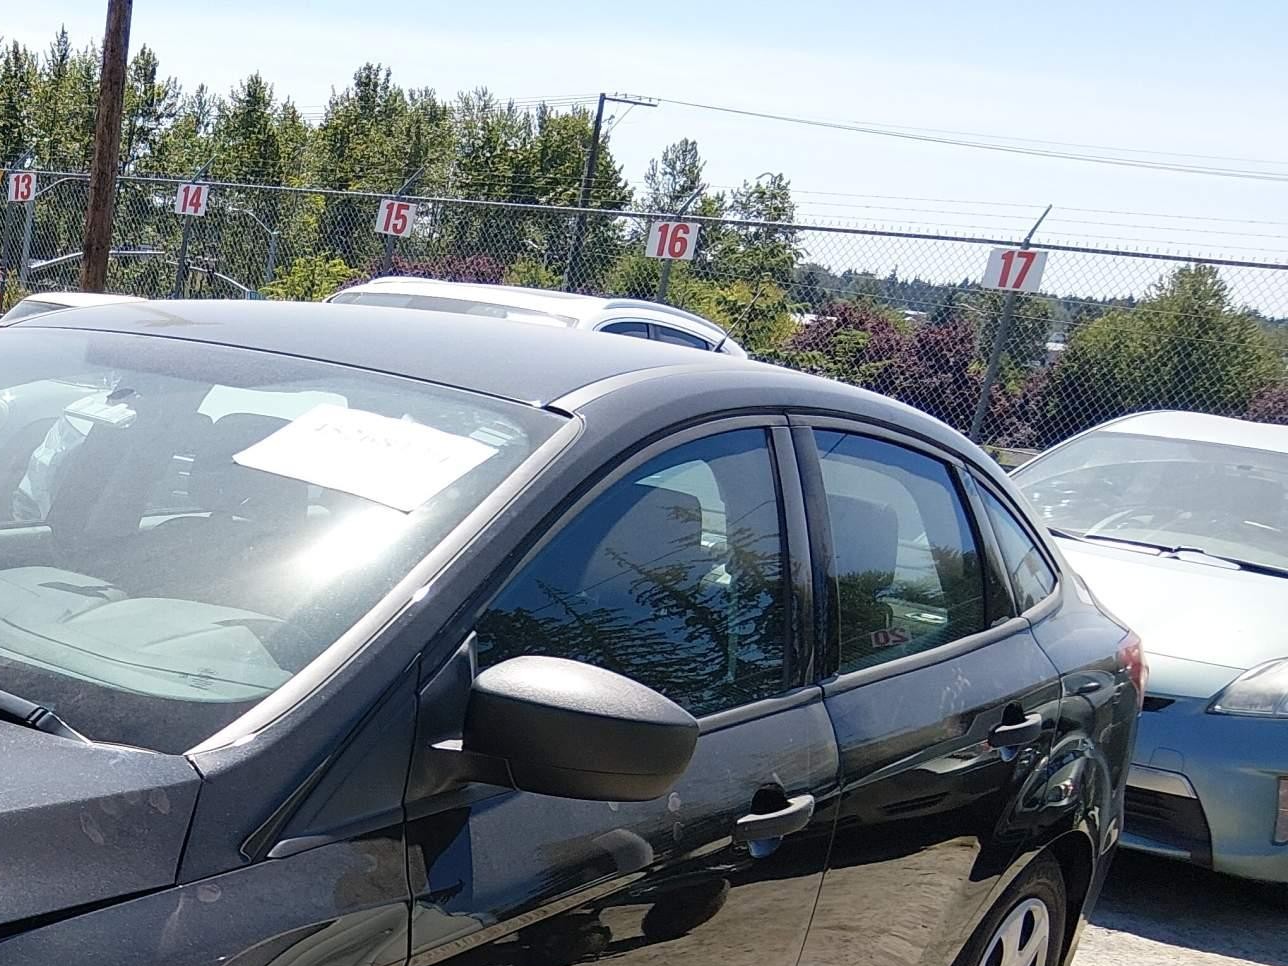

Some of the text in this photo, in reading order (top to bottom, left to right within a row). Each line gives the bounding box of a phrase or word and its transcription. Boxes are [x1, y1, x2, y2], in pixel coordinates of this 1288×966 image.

[14, 174, 32, 200] 13
[181, 185, 202, 214] 14
[383, 202, 410, 235] 15
[657, 223, 690, 258] 16
[998, 250, 1037, 289] 17
